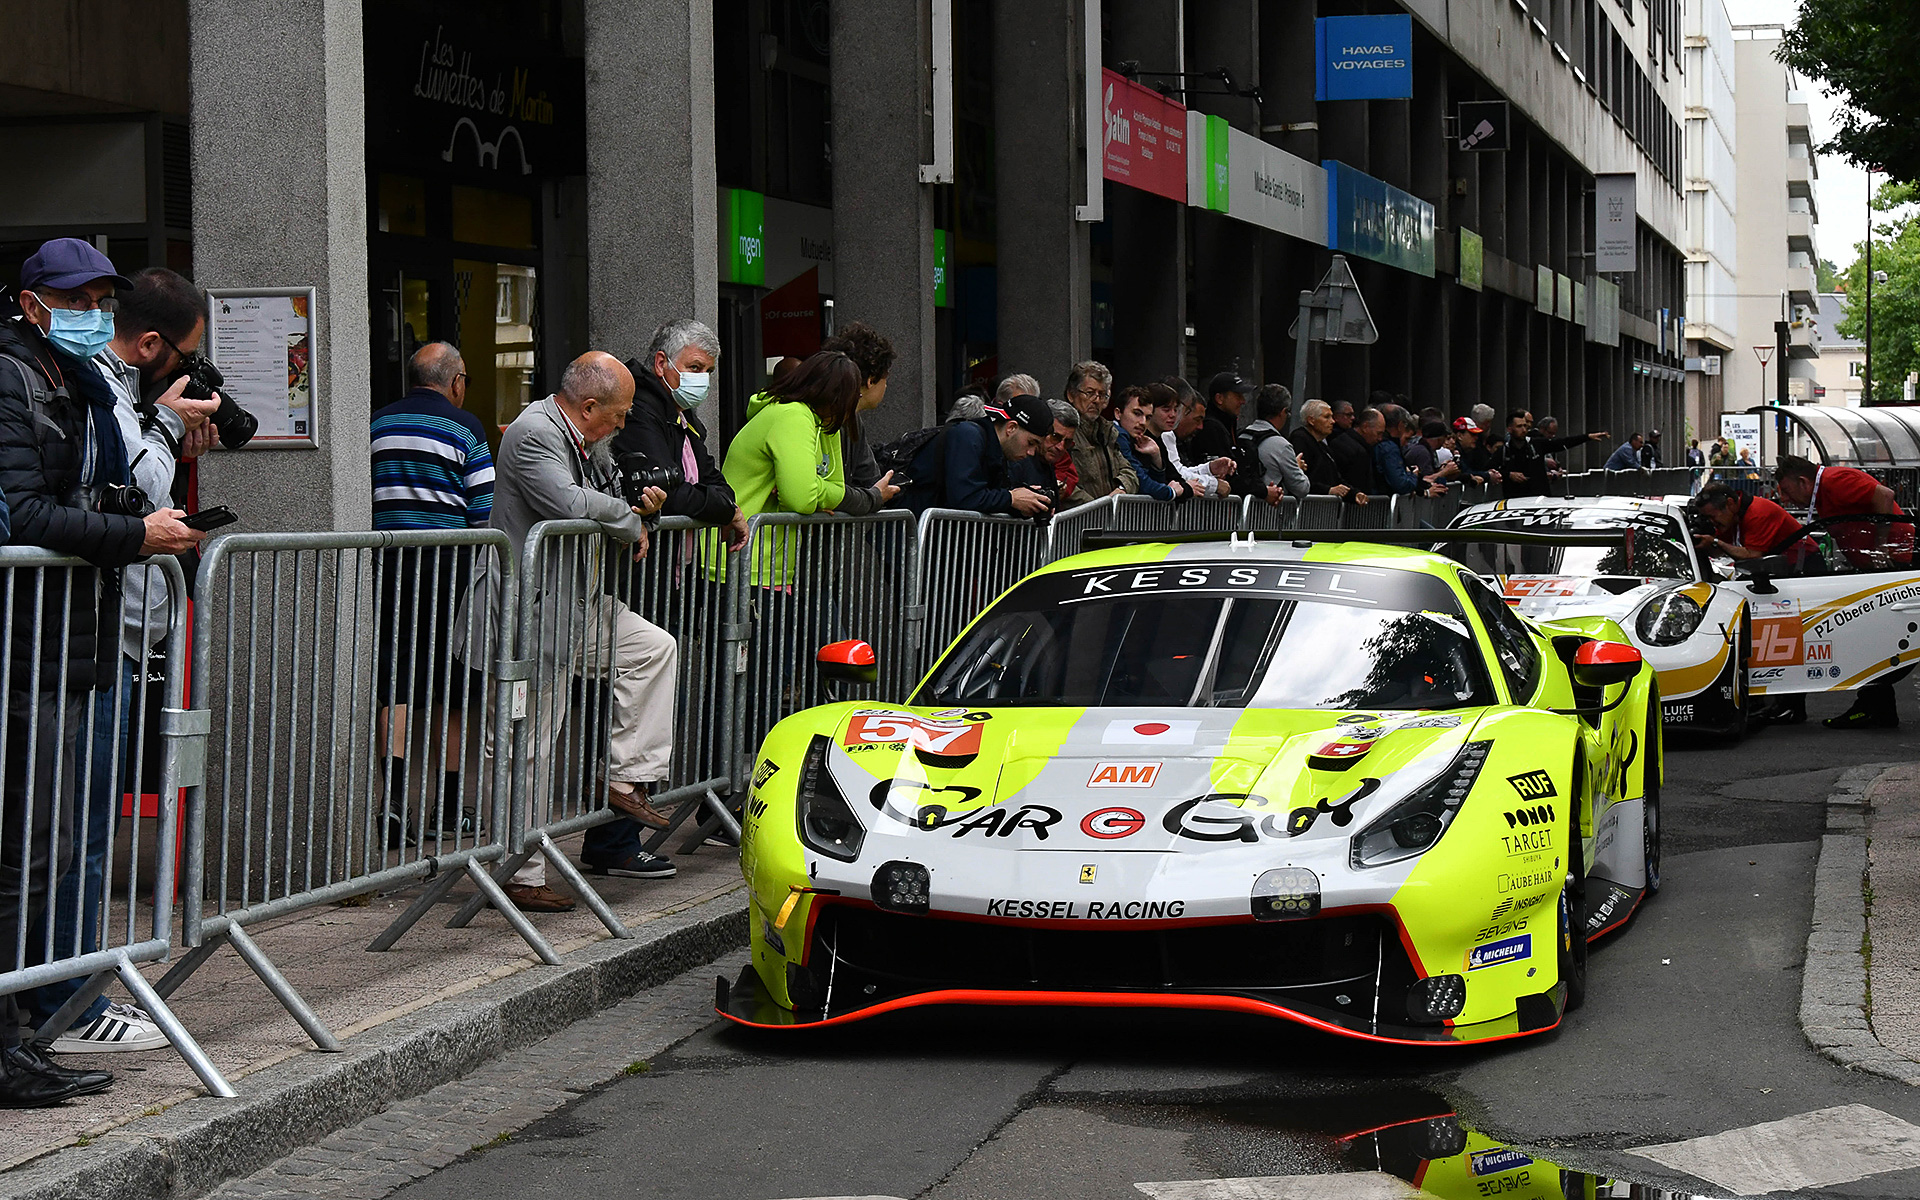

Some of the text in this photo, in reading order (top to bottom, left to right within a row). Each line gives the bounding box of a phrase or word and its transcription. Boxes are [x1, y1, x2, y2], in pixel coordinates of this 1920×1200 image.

[432, 24, 454, 67] Les
[1342, 45, 1394, 56] HAVAS
[1332, 59, 1405, 70] VOYAGES
[414, 40, 554, 125] Lunettes de Martin
[739, 235, 761, 265] mgen
[800, 237, 832, 262] Mutuelle
[782, 309, 814, 318] course
[1083, 568, 1357, 594] KESSEL
[1513, 582, 1563, 596] 46
[1814, 619, 1834, 639] PZ
[1834, 600, 1875, 627] Oberer
[1806, 644, 1831, 661] AM
[1751, 668, 1785, 679] WEC
[1807, 668, 1823, 678] FIA
[1664, 705, 1694, 716] LUKE
[1664, 714, 1694, 723] SPORT
[859, 716, 973, 753] 57
[1090, 765, 1153, 783] AM
[1513, 773, 1549, 797] RUF
[870, 778, 1063, 840] CAR
[1503, 804, 1555, 830] PONOS
[1501, 829, 1552, 854] TARGET
[1523, 854, 1542, 863] SHIBUYA
[1510, 870, 1553, 891] AUBE HAIR
[986, 899, 1186, 919] KESSEL RACING
[1513, 893, 1546, 911] INSIGHT
[1483, 943, 1524, 961] MICHELIN
